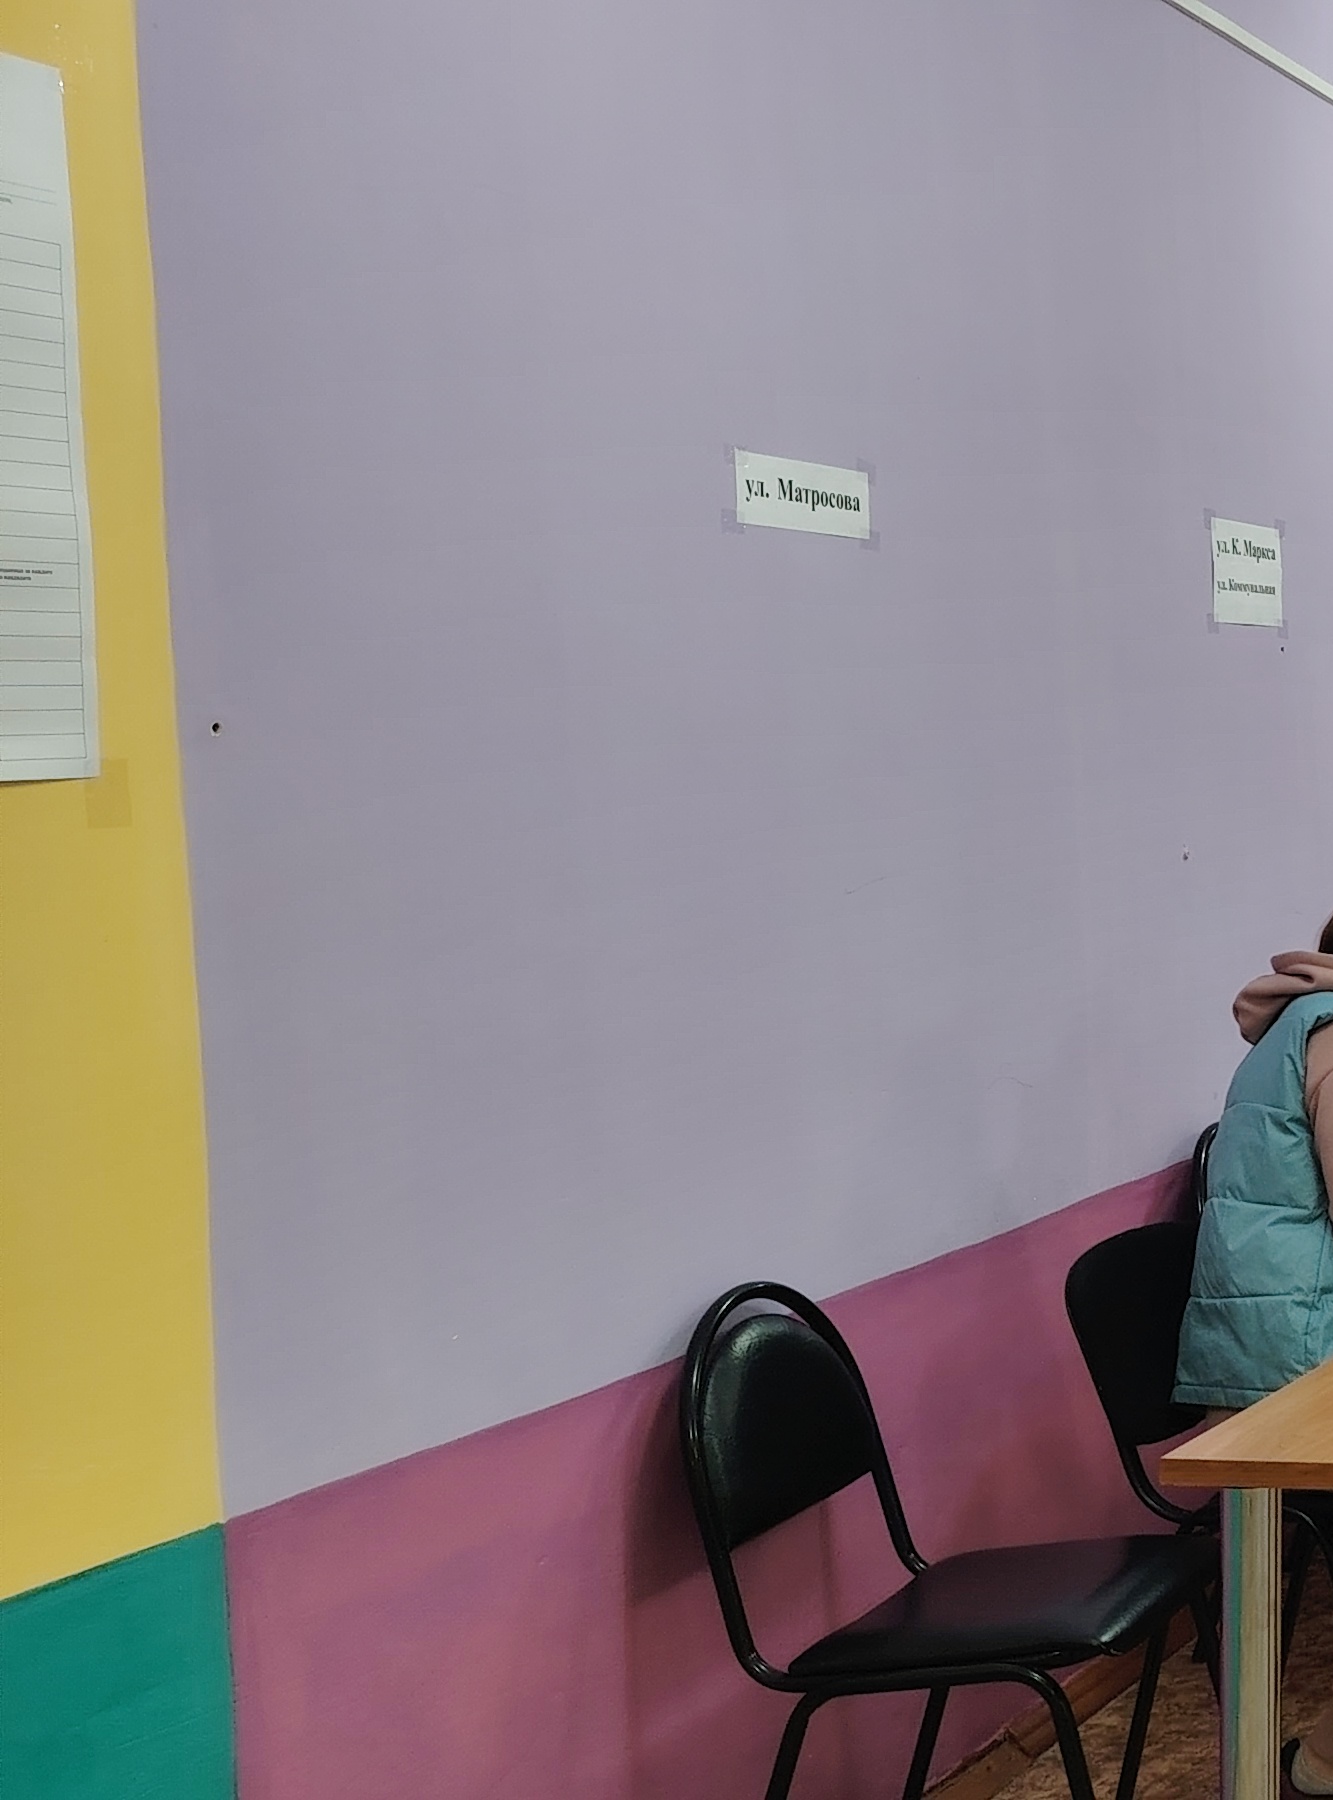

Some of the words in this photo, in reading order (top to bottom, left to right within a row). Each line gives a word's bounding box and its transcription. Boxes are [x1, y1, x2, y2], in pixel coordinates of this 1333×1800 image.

[745, 479, 770, 502] ул.
[777, 478, 861, 512] Матросова
[1216, 540, 1230, 557] ул.
[1231, 538, 1242, 556] К.
[1243, 539, 1276, 563] Маркса
